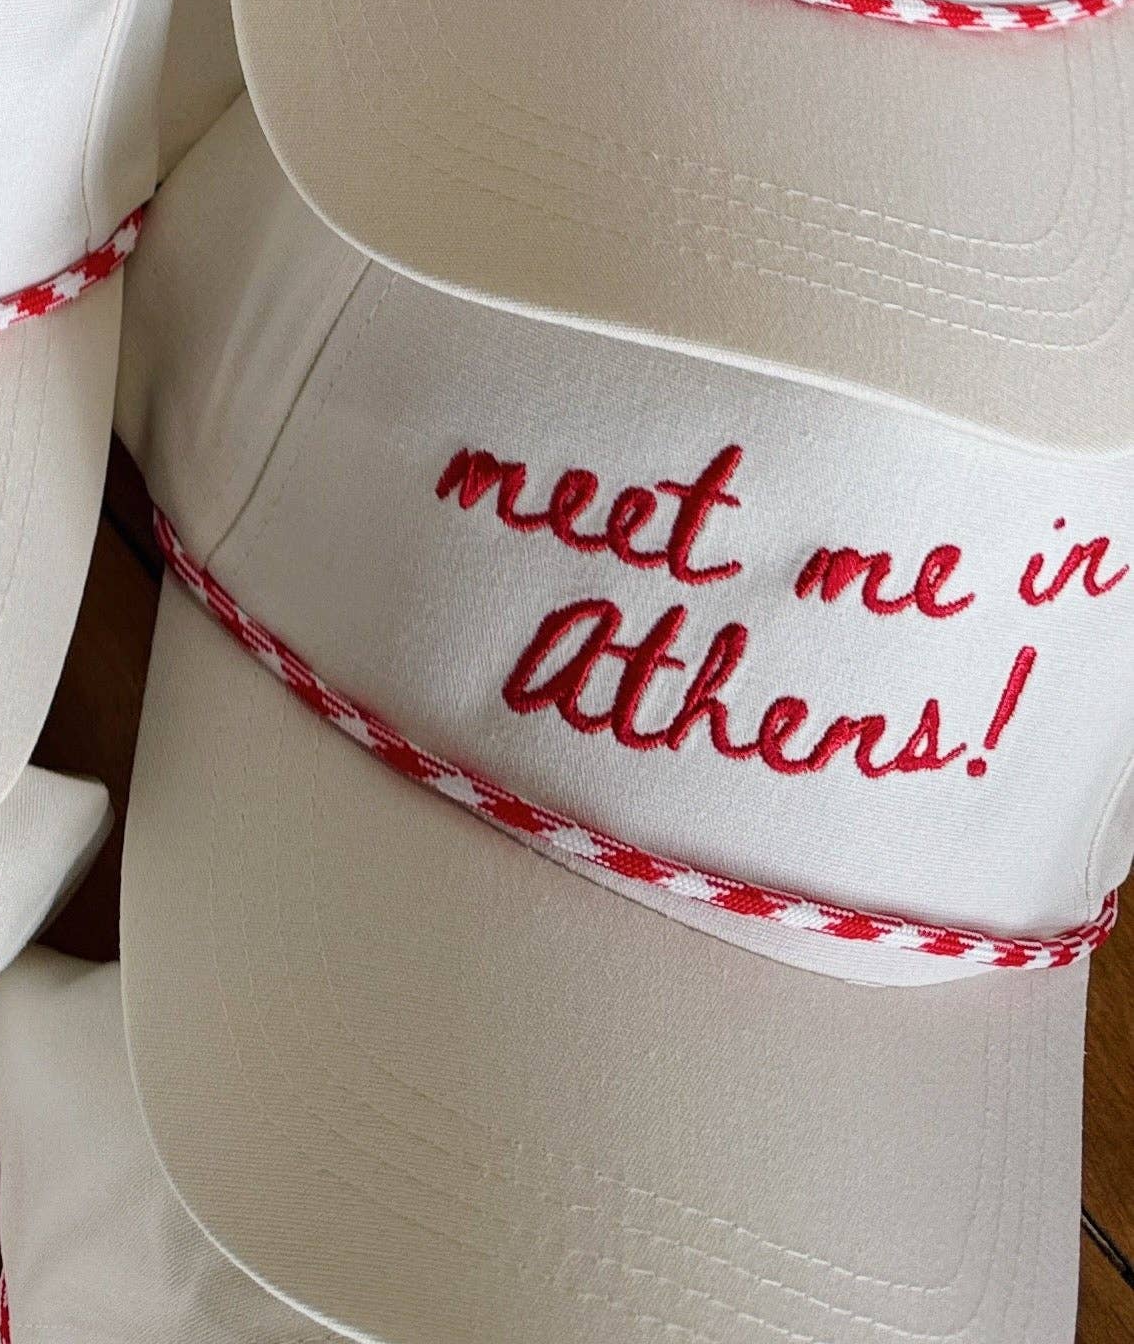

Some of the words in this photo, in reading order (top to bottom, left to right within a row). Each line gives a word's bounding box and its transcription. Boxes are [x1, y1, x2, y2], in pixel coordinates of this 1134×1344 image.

[436, 445, 742, 586] meet
[795, 545, 974, 618] me
[1019, 519, 1128, 606] in
[507, 599, 1036, 778] Athens!
